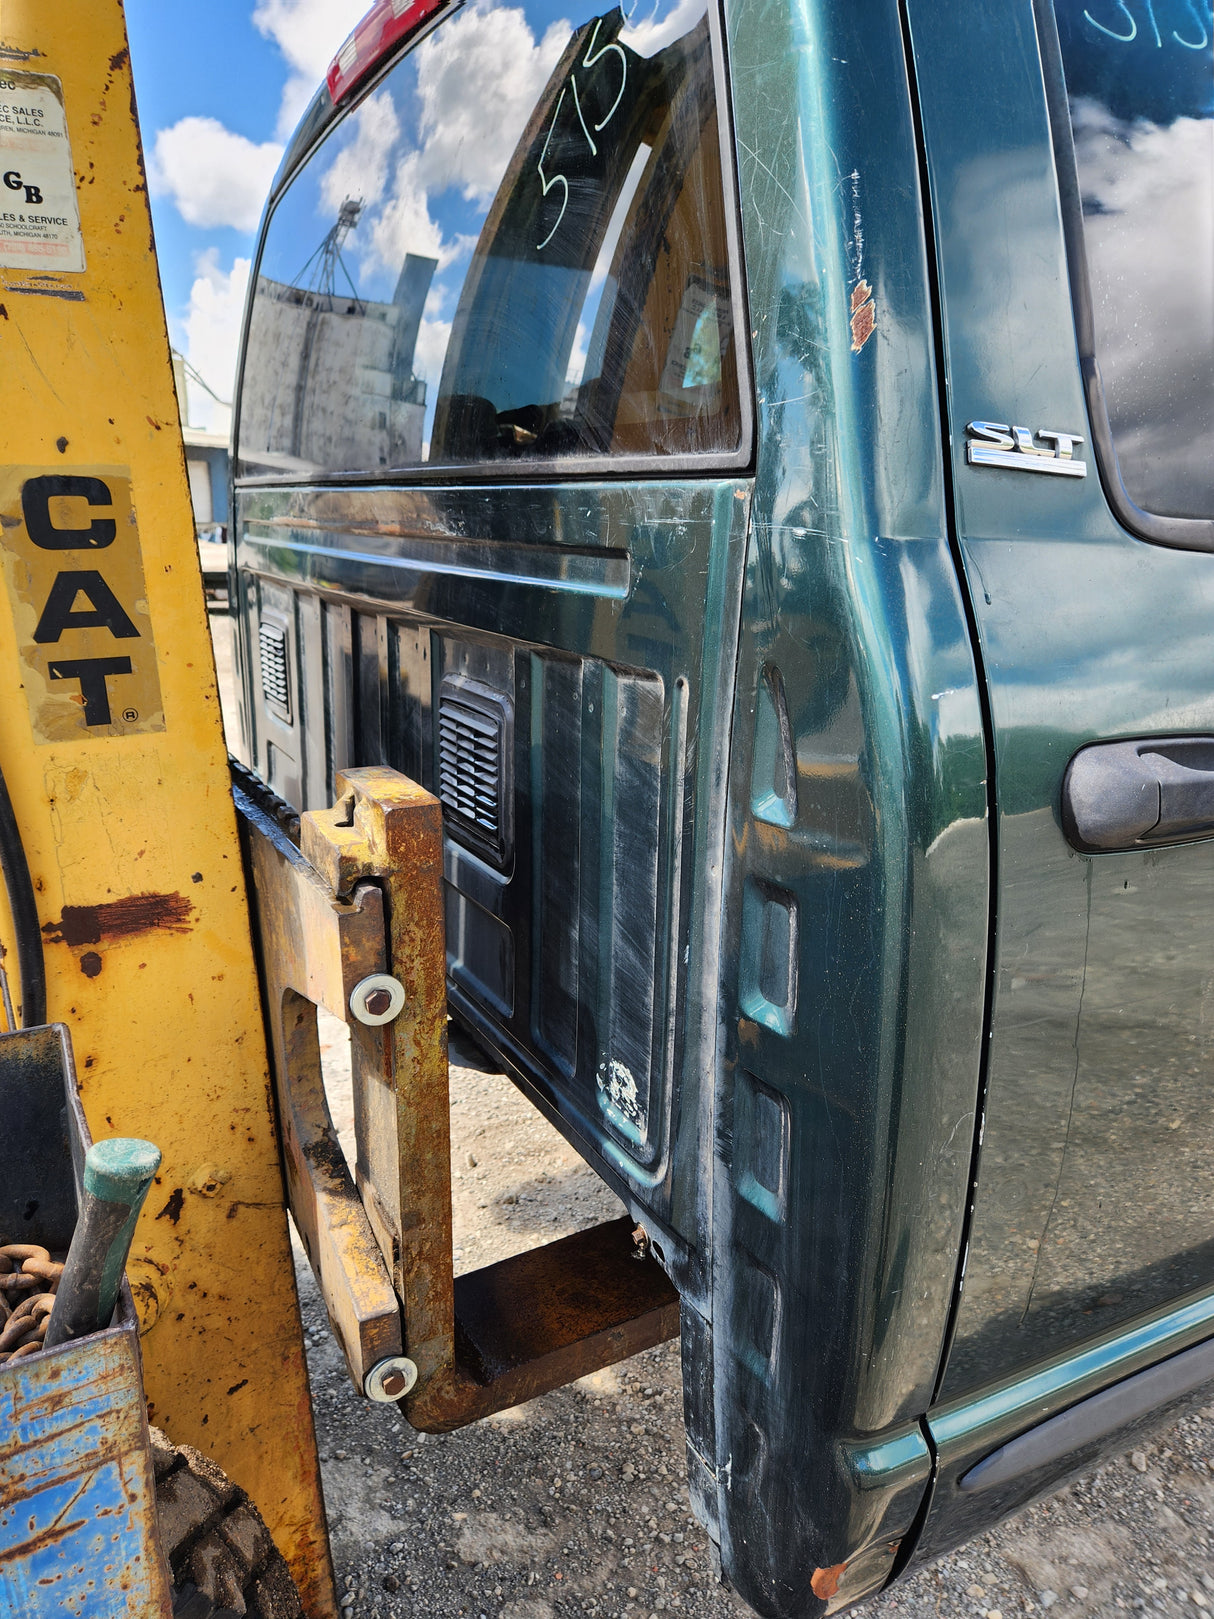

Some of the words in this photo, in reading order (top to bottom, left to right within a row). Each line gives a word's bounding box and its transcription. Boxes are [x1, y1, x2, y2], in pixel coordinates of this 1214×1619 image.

[12, 106, 44, 117] SALES
[16, 127, 46, 135] MICHIGAN
[19, 214, 25, 222] &
[28, 215, 68, 226] SERVICE
[13, 231, 42, 239] MICHIGAN
[967, 420, 1085, 460] SLT
[21, 474, 141, 727] CAT
